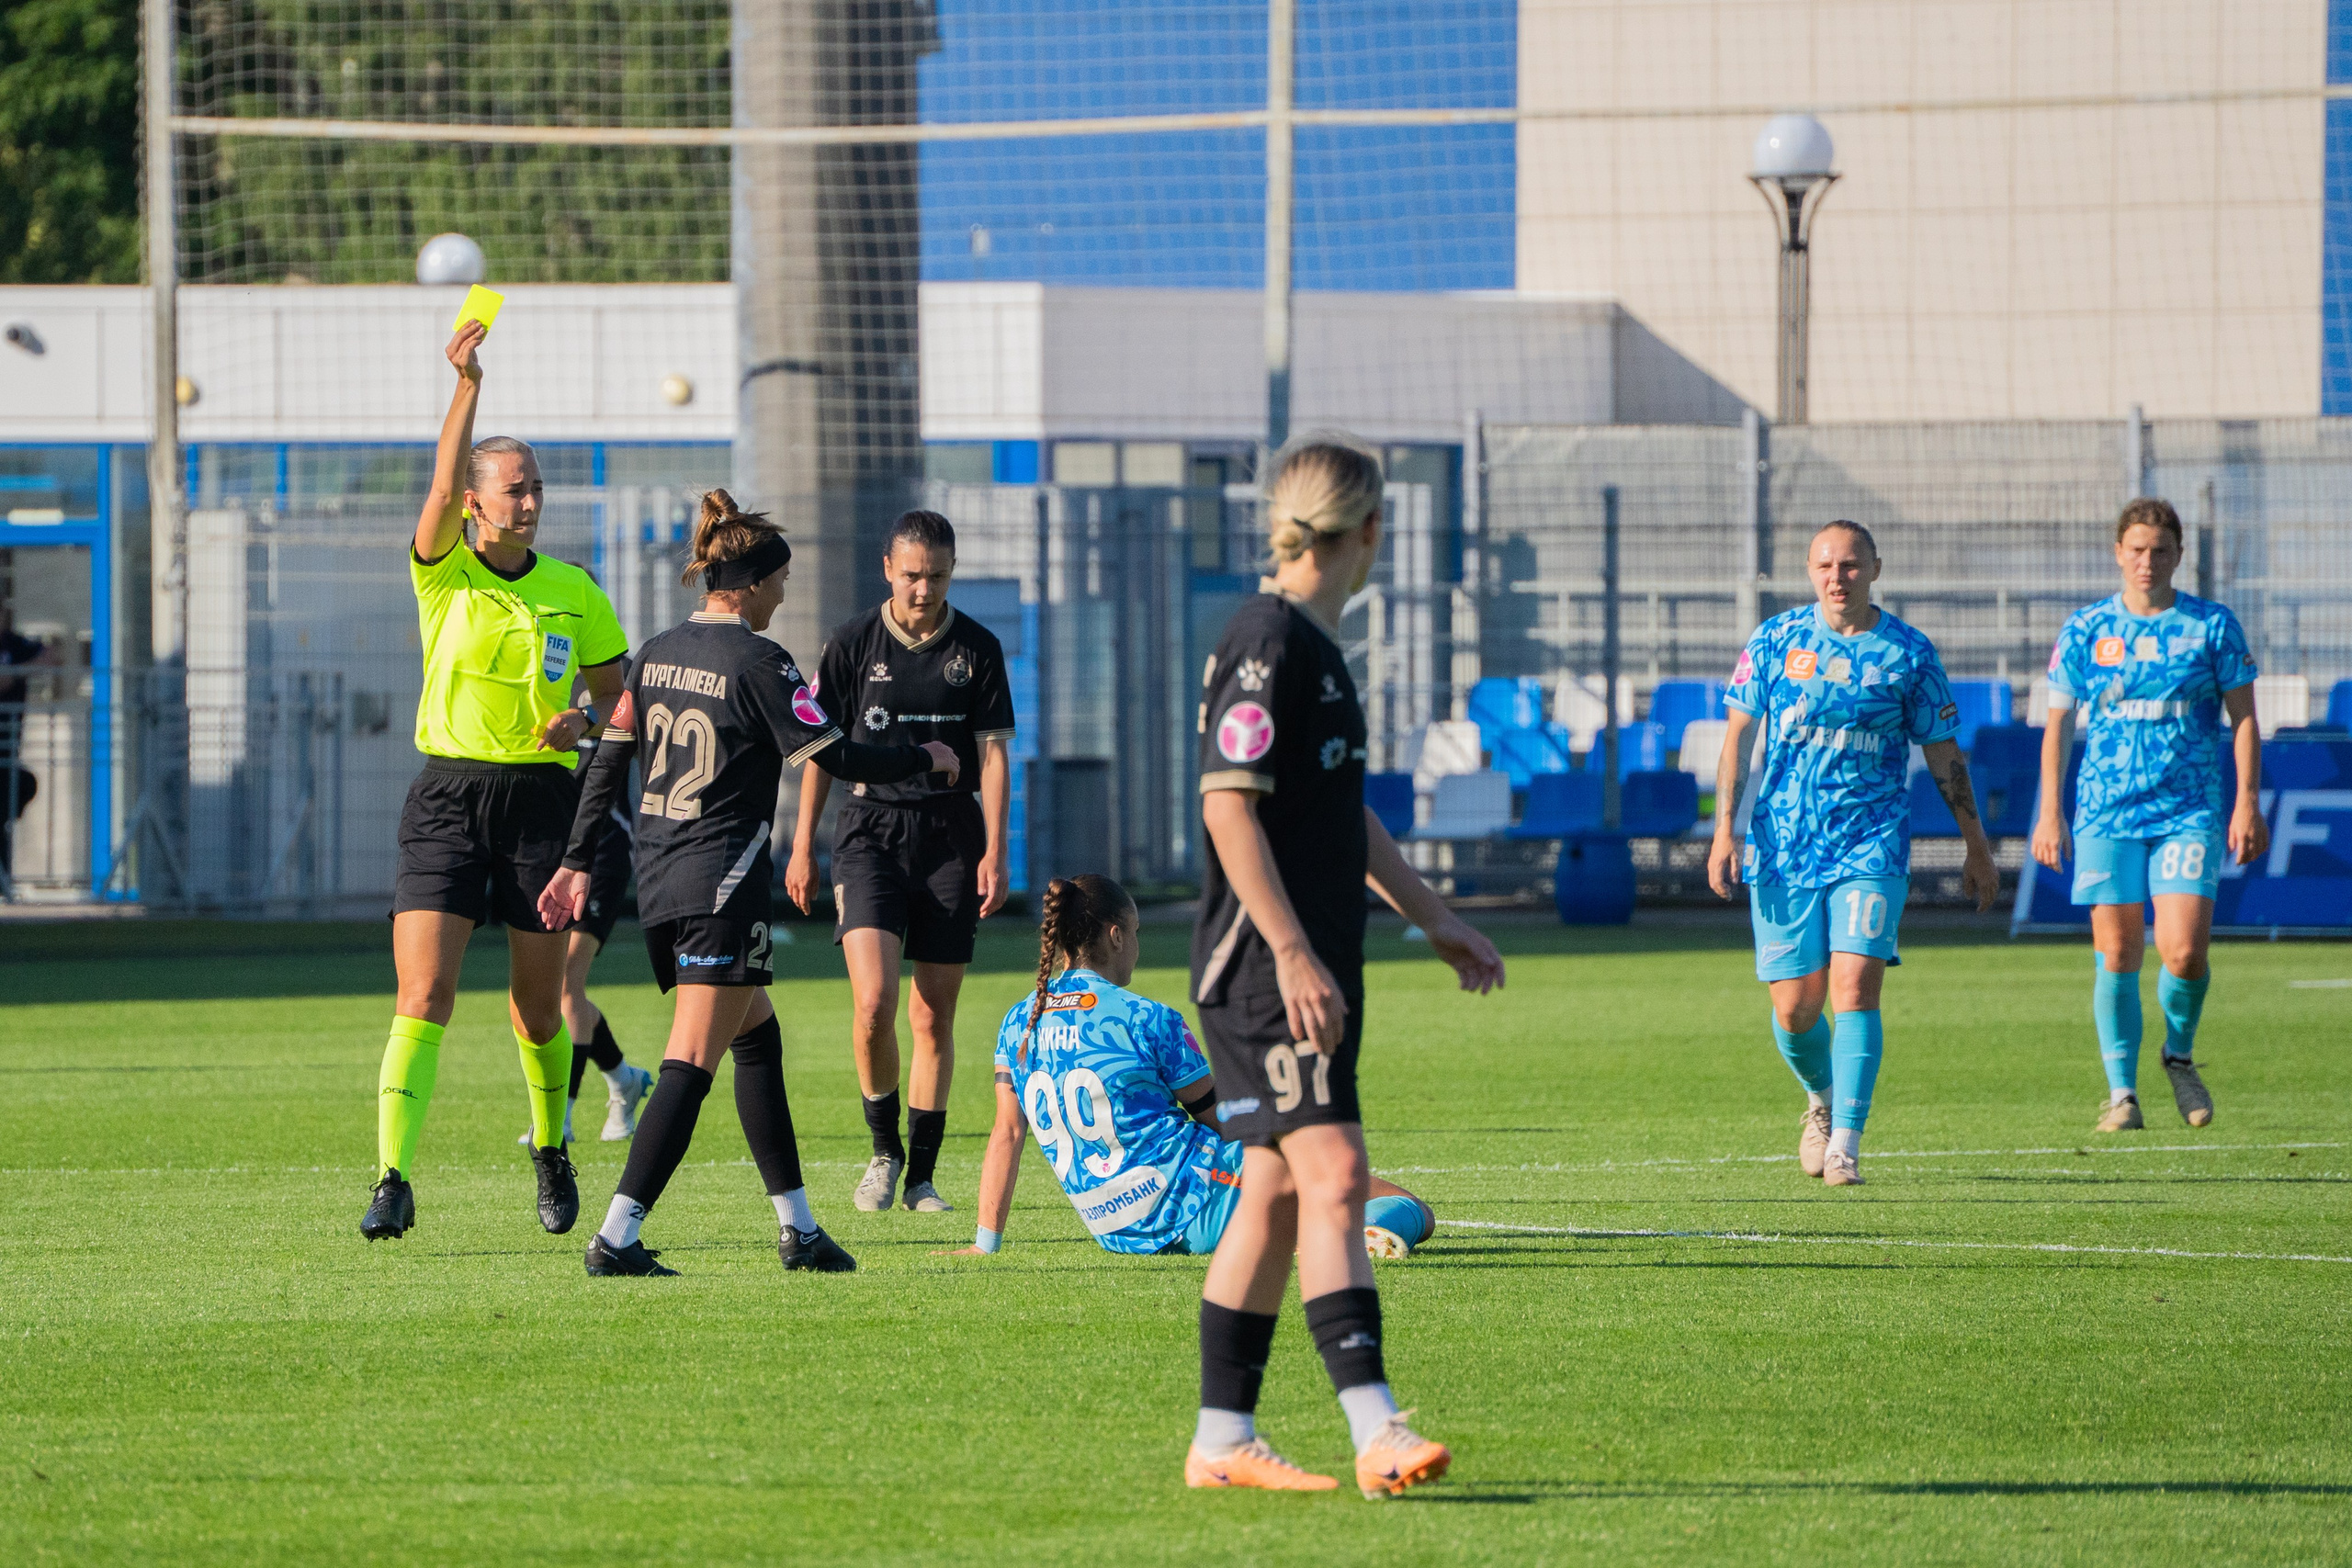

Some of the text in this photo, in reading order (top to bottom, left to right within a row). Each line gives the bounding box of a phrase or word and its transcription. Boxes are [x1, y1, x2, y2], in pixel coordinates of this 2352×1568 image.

[544, 654, 566, 666] REFEREE
[547, 636, 569, 652] FIFA
[642, 663, 727, 700] НУРГАЛИЕВА
[639, 703, 717, 820] 22
[2161, 841, 2206, 881] 88
[1845, 889, 1888, 940] 10
[1264, 1040, 1331, 1113] 97
[1023, 1067, 1125, 1183] 99
[1080, 1177, 1161, 1223] ГАЗПРОМБАНК
